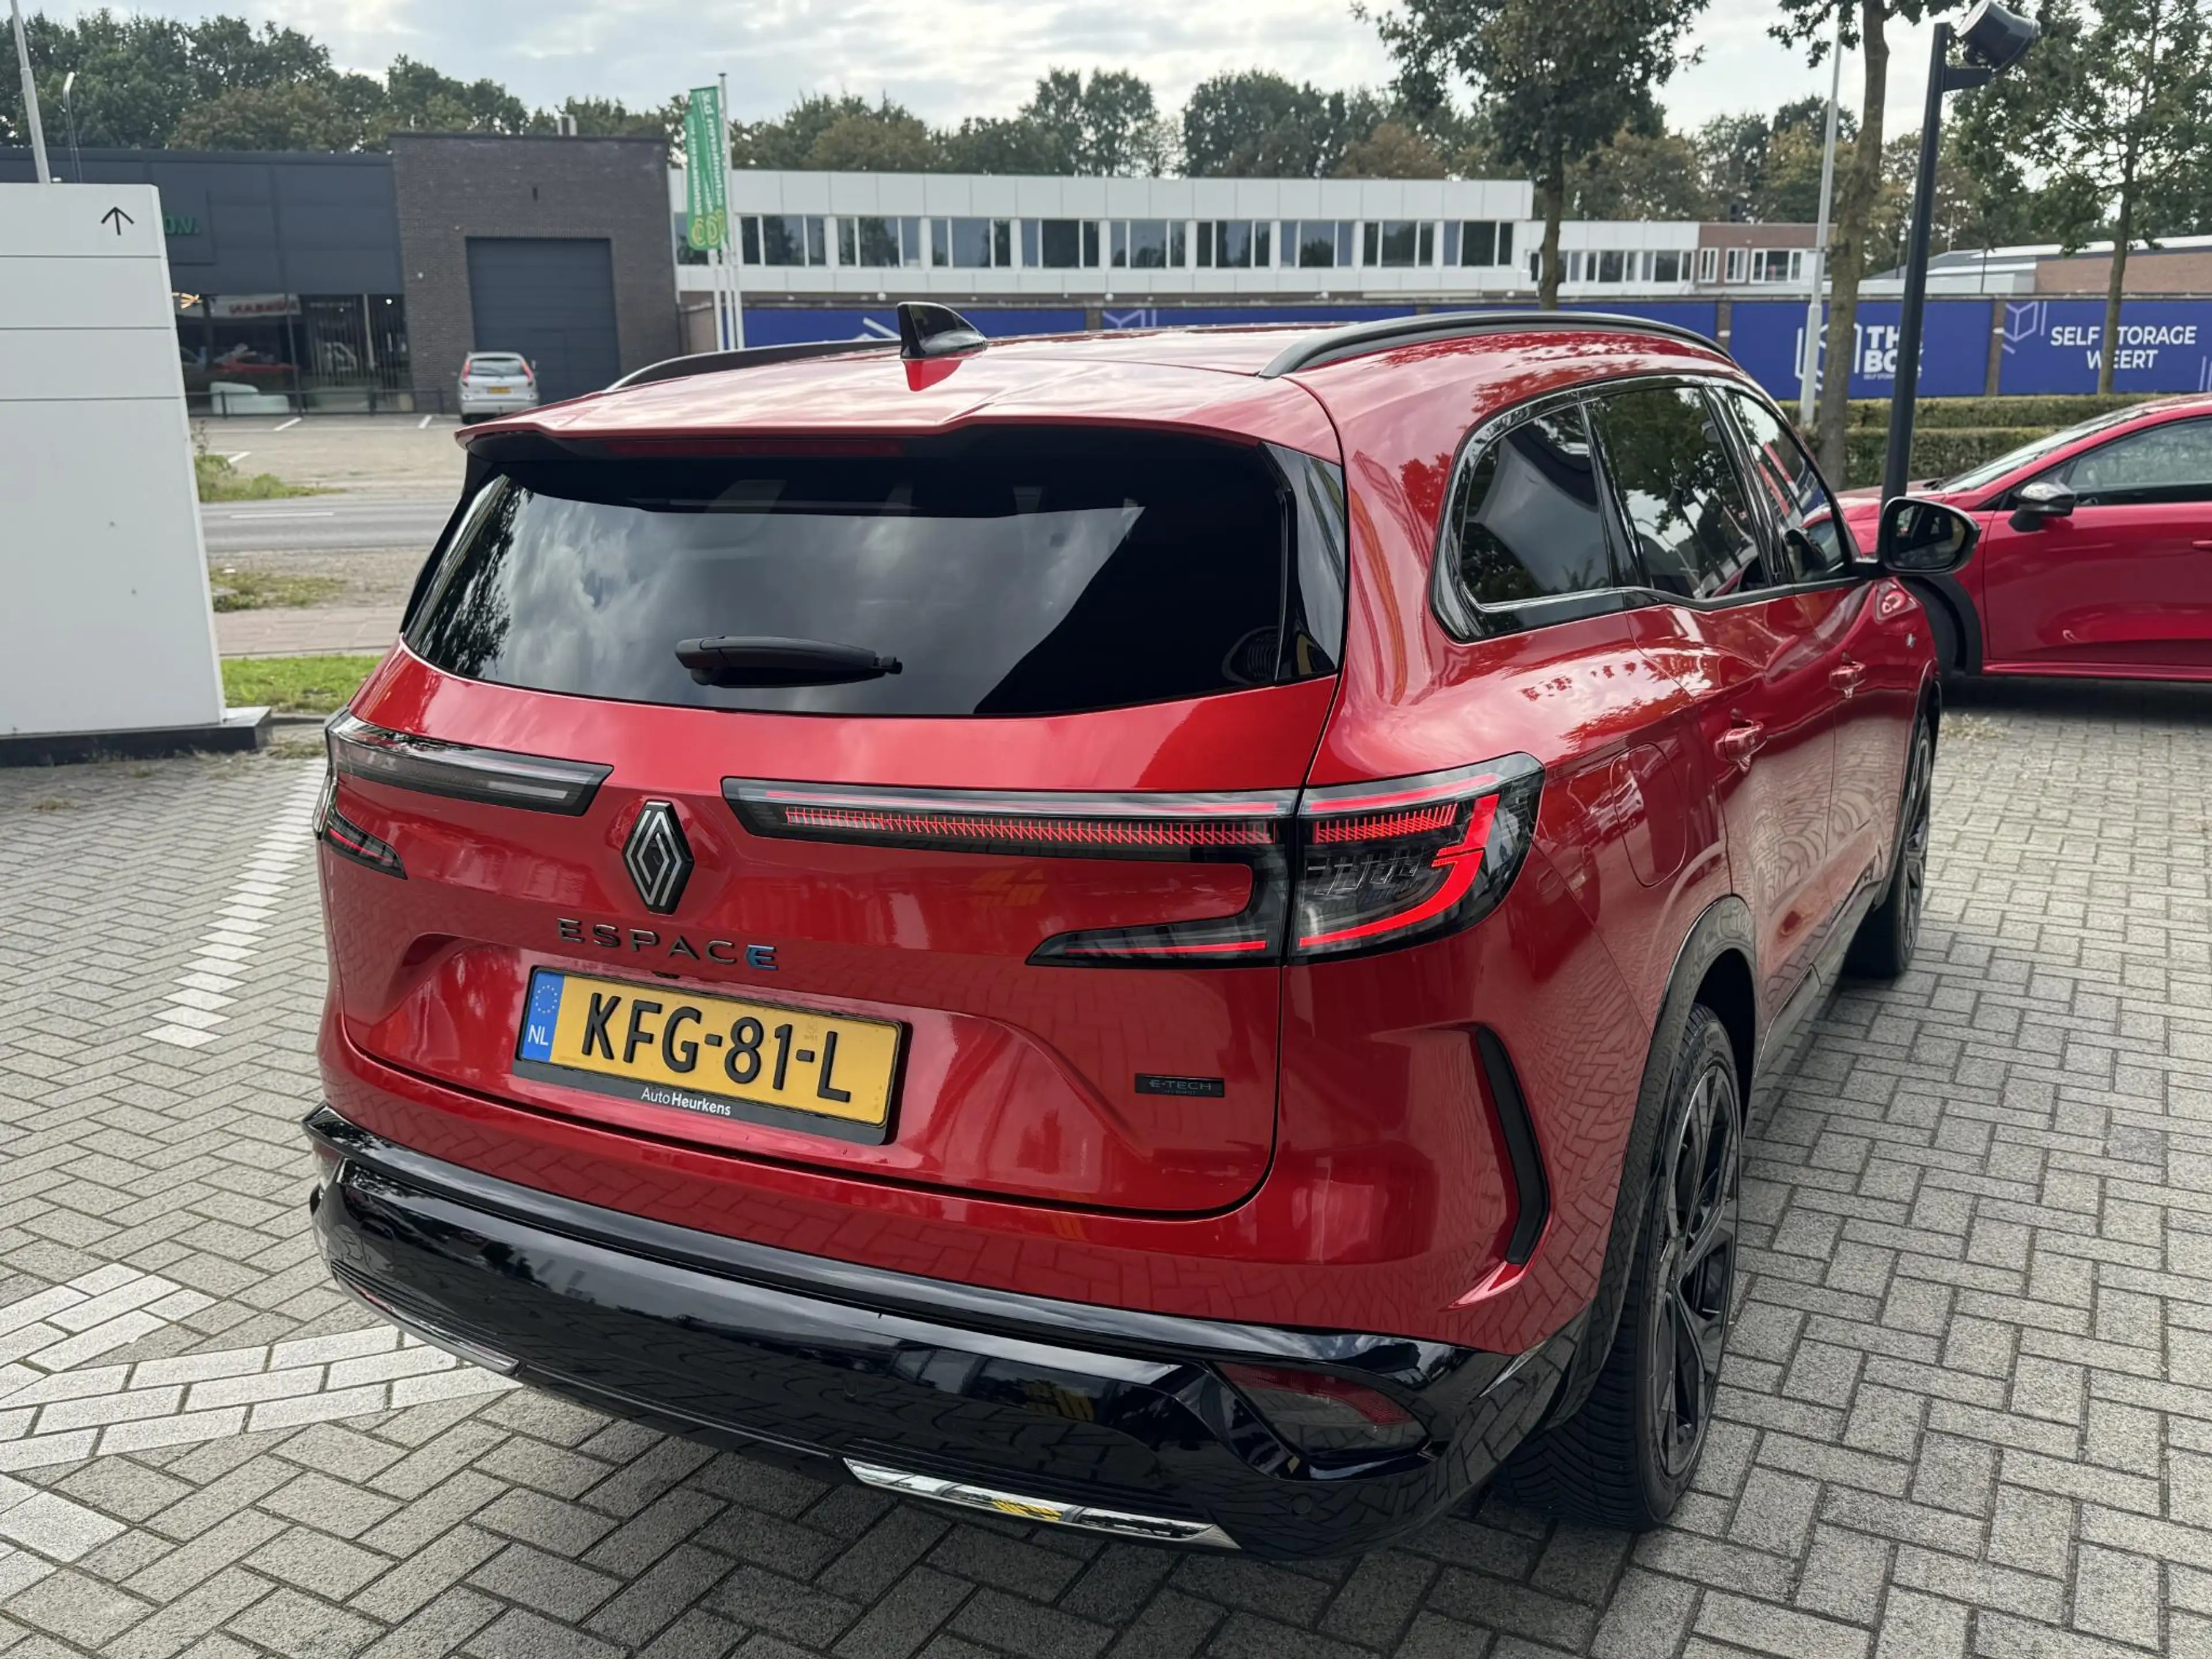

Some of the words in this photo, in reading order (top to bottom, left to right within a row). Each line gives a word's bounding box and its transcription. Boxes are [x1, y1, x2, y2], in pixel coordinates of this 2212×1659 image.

[1866, 325, 1923, 349] TH
[2050, 326, 2101, 346] SELF
[2117, 325, 2198, 345] TORAGE
[1863, 349, 1925, 373] BO
[557, 918, 778, 971] ESPACE
[528, 1024, 548, 1046] NL
[582, 992, 851, 1103] KFG-81-L
[1149, 1079, 1212, 1090] E-TECH
